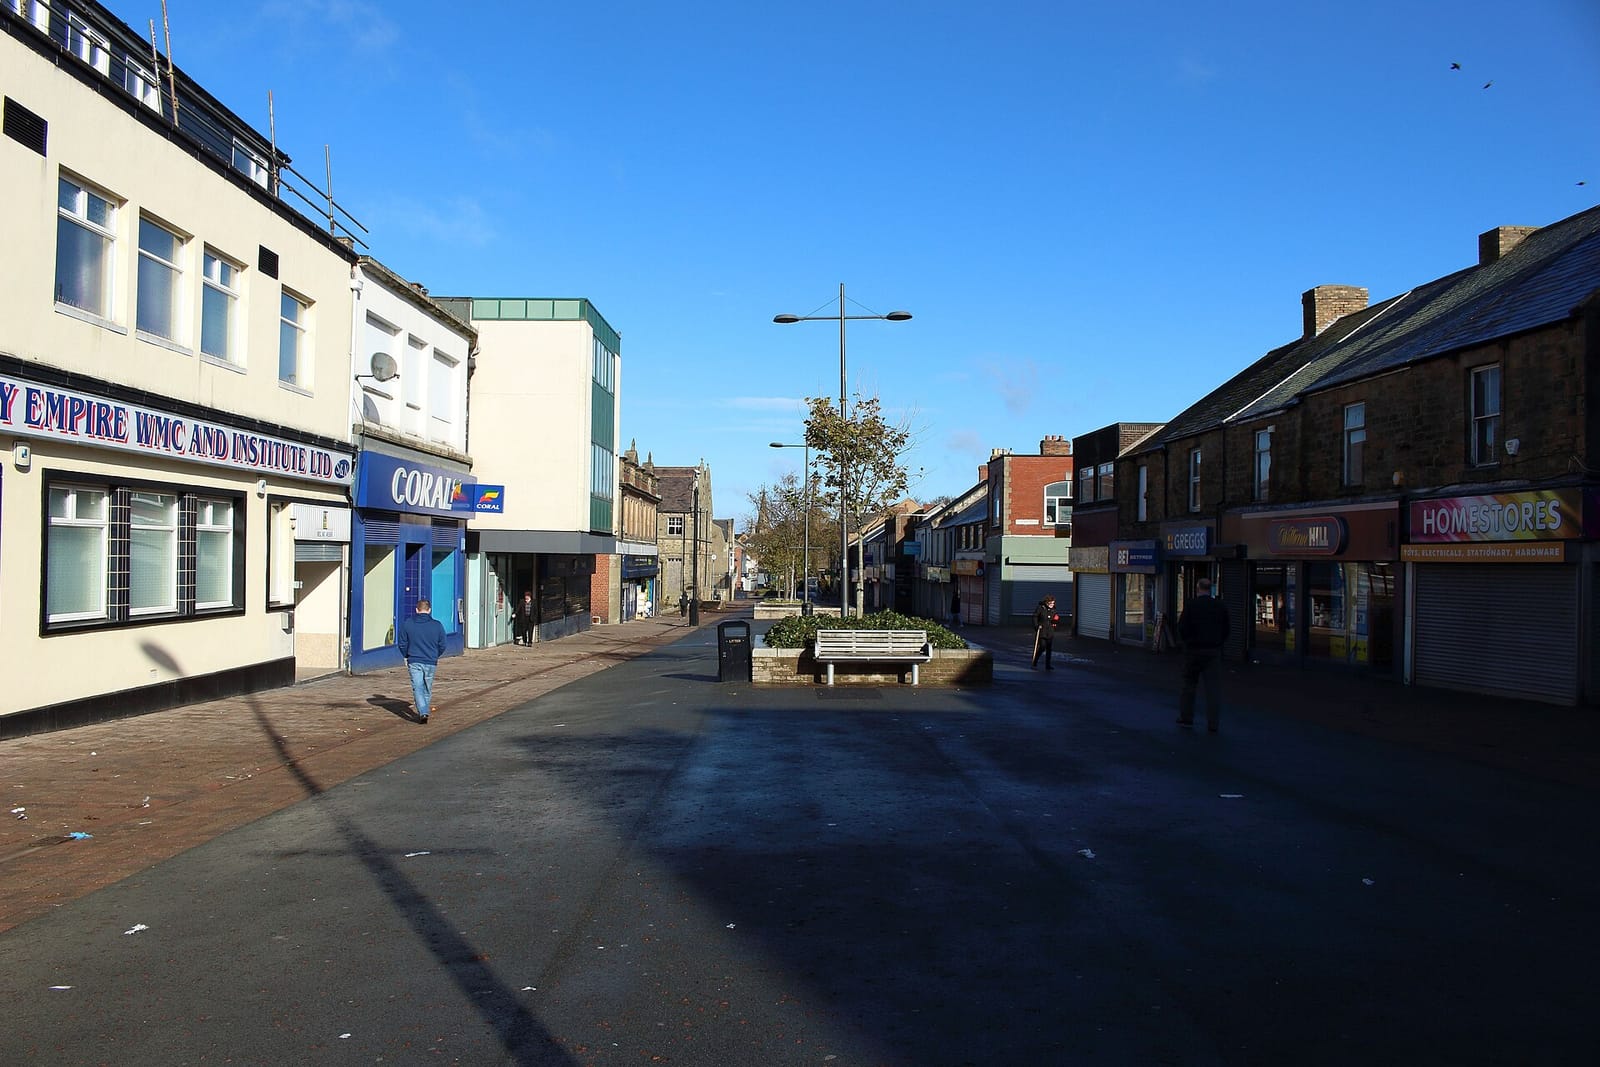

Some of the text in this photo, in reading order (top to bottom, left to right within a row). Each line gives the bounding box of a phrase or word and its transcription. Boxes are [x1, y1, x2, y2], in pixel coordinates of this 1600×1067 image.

[24, 387, 129, 443] EMPIRE
[135, 411, 186, 455] WMC
[189, 424, 229, 460] AND
[231, 433, 308, 474] INSTITUTE
[310, 449, 333, 478] LTD
[392, 467, 453, 510] CORAL
[1423, 499, 1563, 535] HOMESTORES
[1174, 533, 1206, 550] GREGGS
[1308, 526, 1328, 547] HILL
[1515, 547, 1560, 556] HARDWARE
